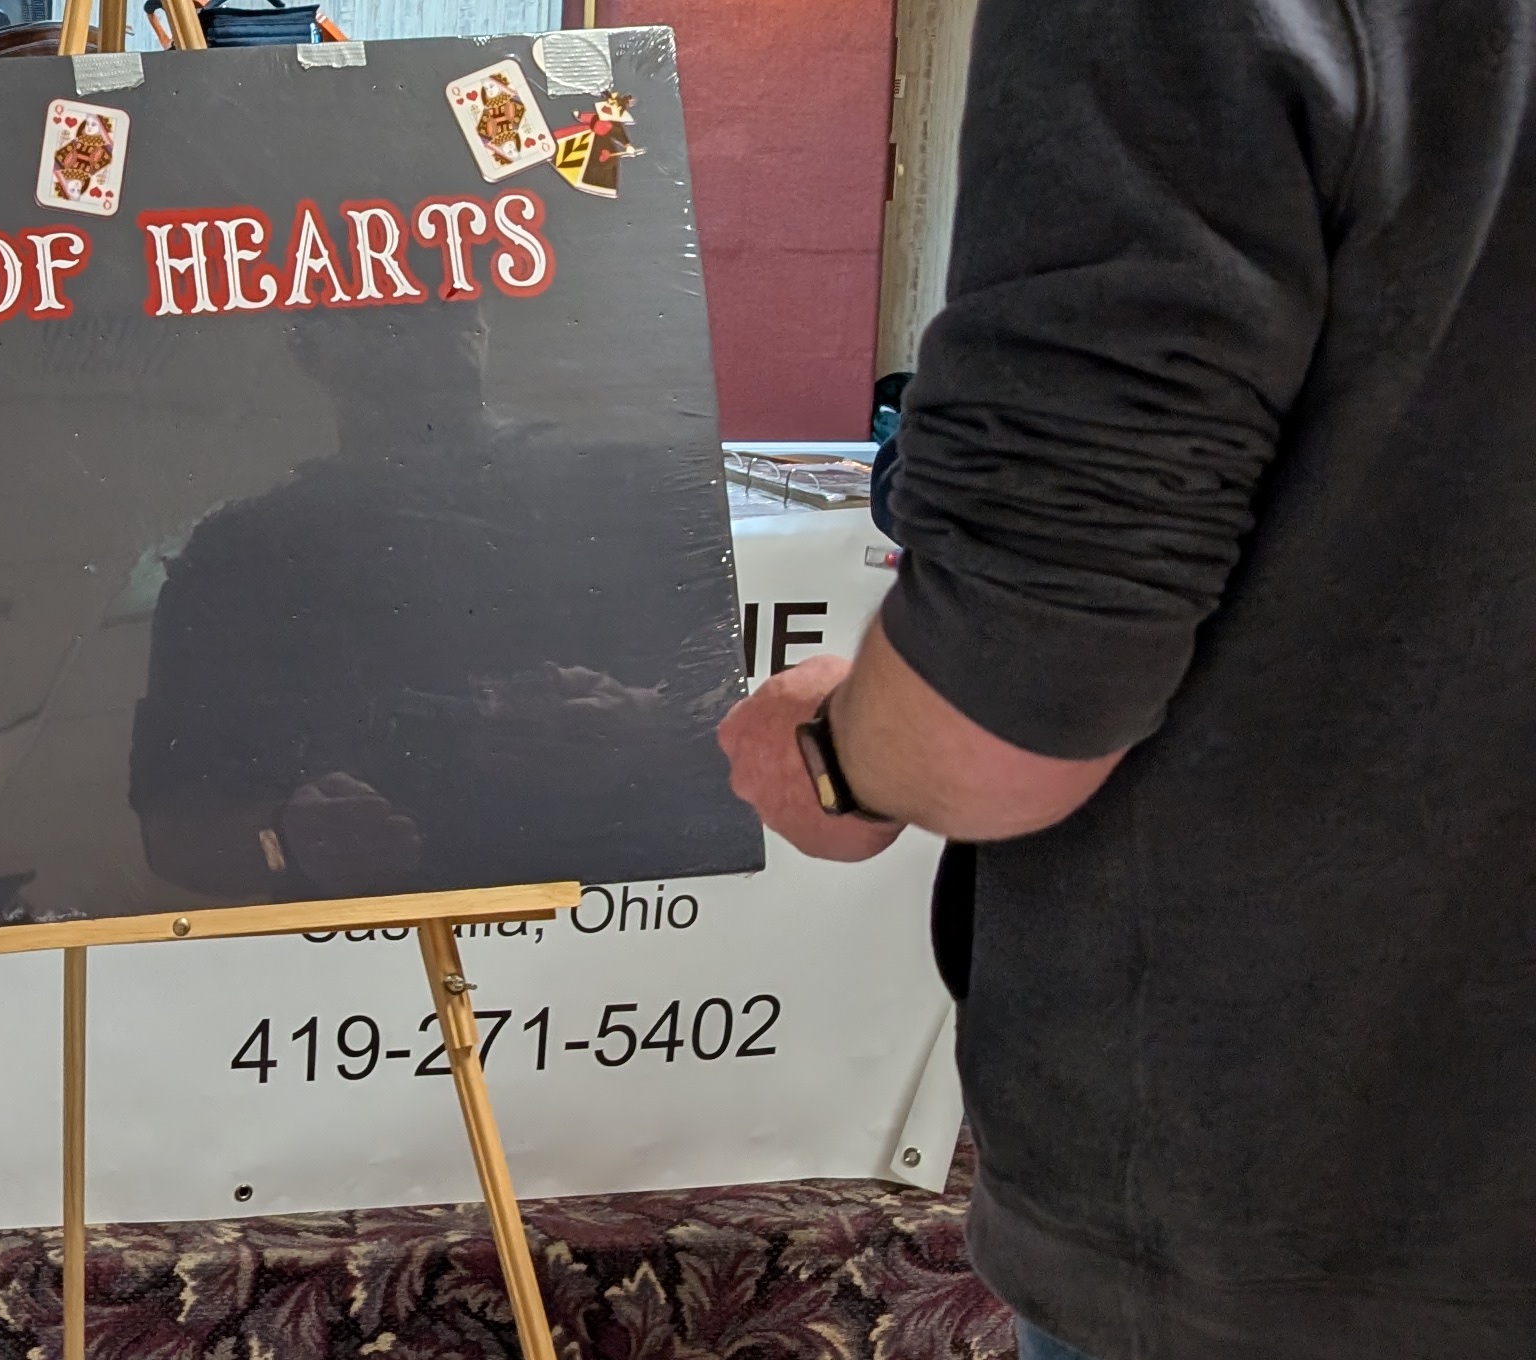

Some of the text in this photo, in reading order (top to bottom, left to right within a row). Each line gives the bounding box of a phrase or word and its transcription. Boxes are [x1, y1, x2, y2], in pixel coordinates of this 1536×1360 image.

[147, 194, 547, 317] HEARTS
[569, 884, 700, 934] Ohio
[229, 993, 782, 1084] 419-271-5402
